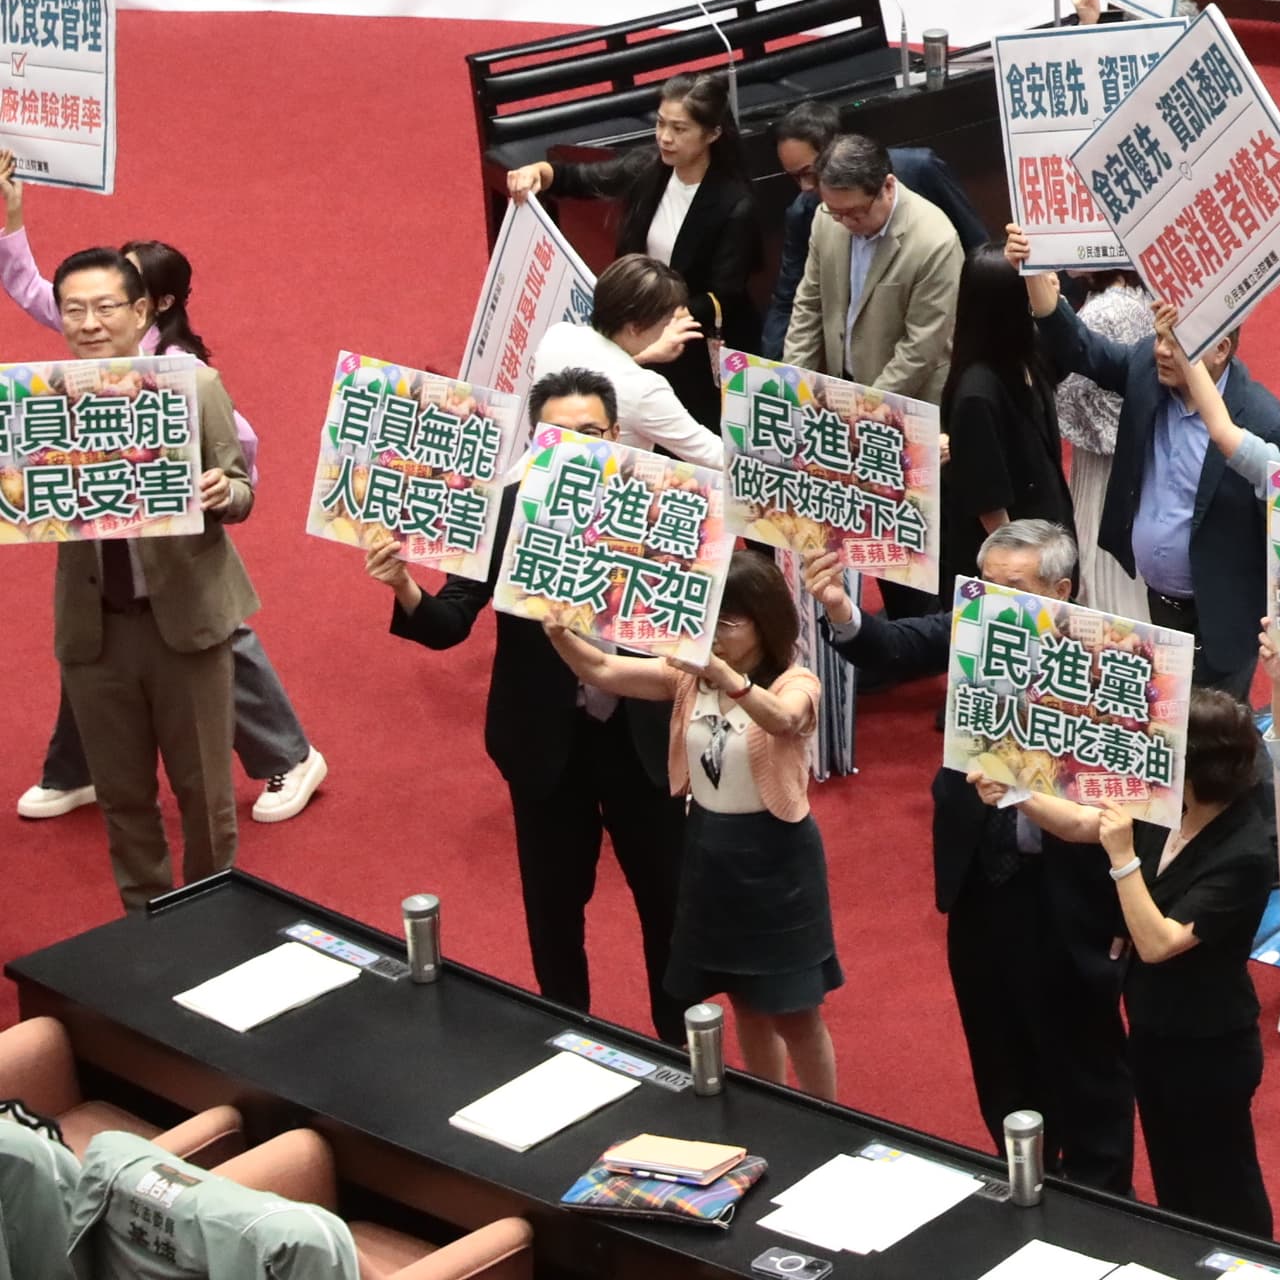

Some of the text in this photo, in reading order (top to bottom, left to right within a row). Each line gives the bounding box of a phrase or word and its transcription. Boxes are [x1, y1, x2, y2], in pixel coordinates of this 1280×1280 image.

[1006, 51, 1162, 120] 食安優先 資訊
[1091, 42, 1244, 226] 食安優先 資訊透明
[1017, 154, 1106, 226] 保障消
[0, 389, 191, 455] 員無能
[337, 385, 501, 481] 官員無能
[751, 390, 908, 491] 民進黨
[320, 456, 490, 552] 人民受害
[548, 461, 709, 560] 民進黨
[729, 454, 928, 553] 做不好就下台
[510, 523, 713, 639] 最該下架
[850, 542, 906, 564] 毒蘋果
[980, 618, 1152, 723] 民進黨
[954, 683, 1175, 786] 讓人民吃毒油
[1082, 778, 1146, 799] 毒蘋果
